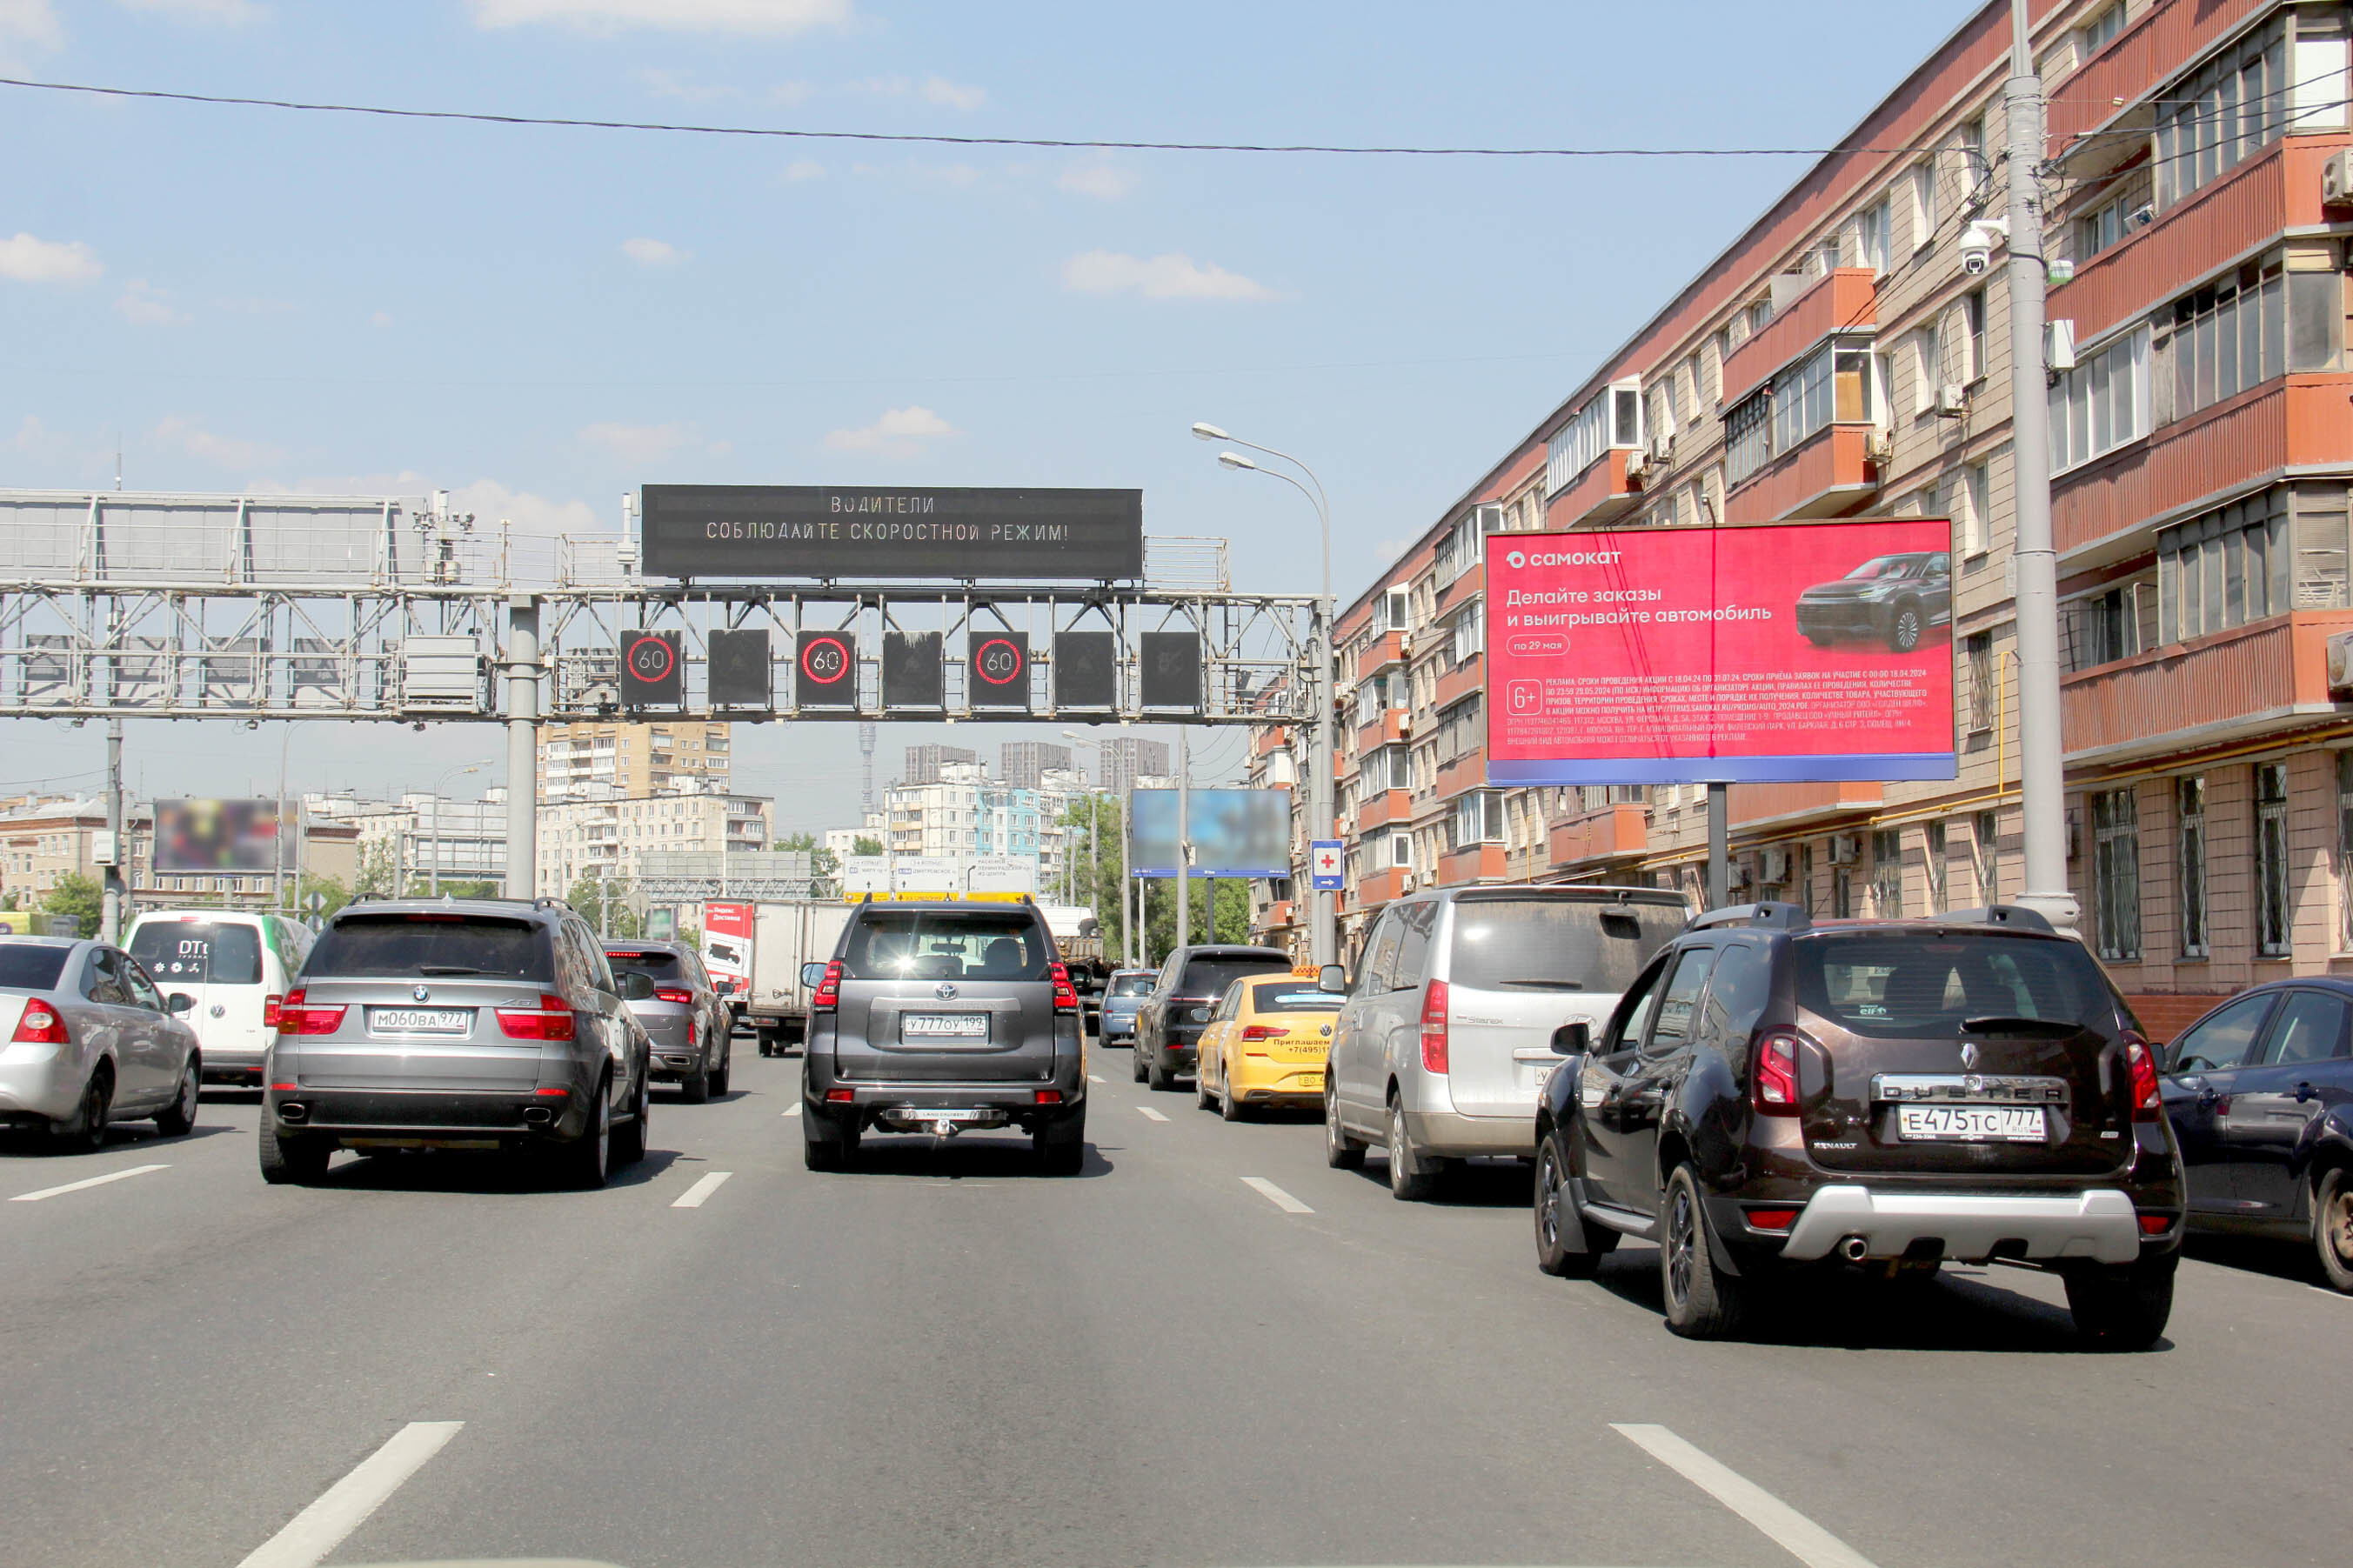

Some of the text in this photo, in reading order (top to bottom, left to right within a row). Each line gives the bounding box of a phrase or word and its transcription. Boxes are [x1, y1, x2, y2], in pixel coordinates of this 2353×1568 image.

[831, 496, 934, 514] ВОДИТЕЛИ
[706, 522, 1068, 541] СОБЛЮДАЙТЕ СКОРОСТНОЙ РЕЖИМ!
[1530, 550, 1621, 566] самокат
[1507, 588, 1661, 607] Делайте заказы
[1507, 604, 1772, 629] и выигрывайте автомобиль
[1514, 642, 1527, 651] по
[1528, 641, 1541, 650] 29
[638, 651, 664, 670] 60
[813, 651, 839, 670] 60
[986, 652, 1012, 671] 60
[1601, 677, 1642, 685] ПРОВЕДЕНИЯ
[1514, 686, 1536, 709] 6+
[378, 1011, 463, 1026] М060ВА 977
[911, 1017, 982, 1030] У777ОУ 199
[1273, 1038, 1330, 1047] Приглашаем
[1883, 1087, 2062, 1100] DUSTER
[1908, 1108, 2035, 1131] Е475ТС 777
